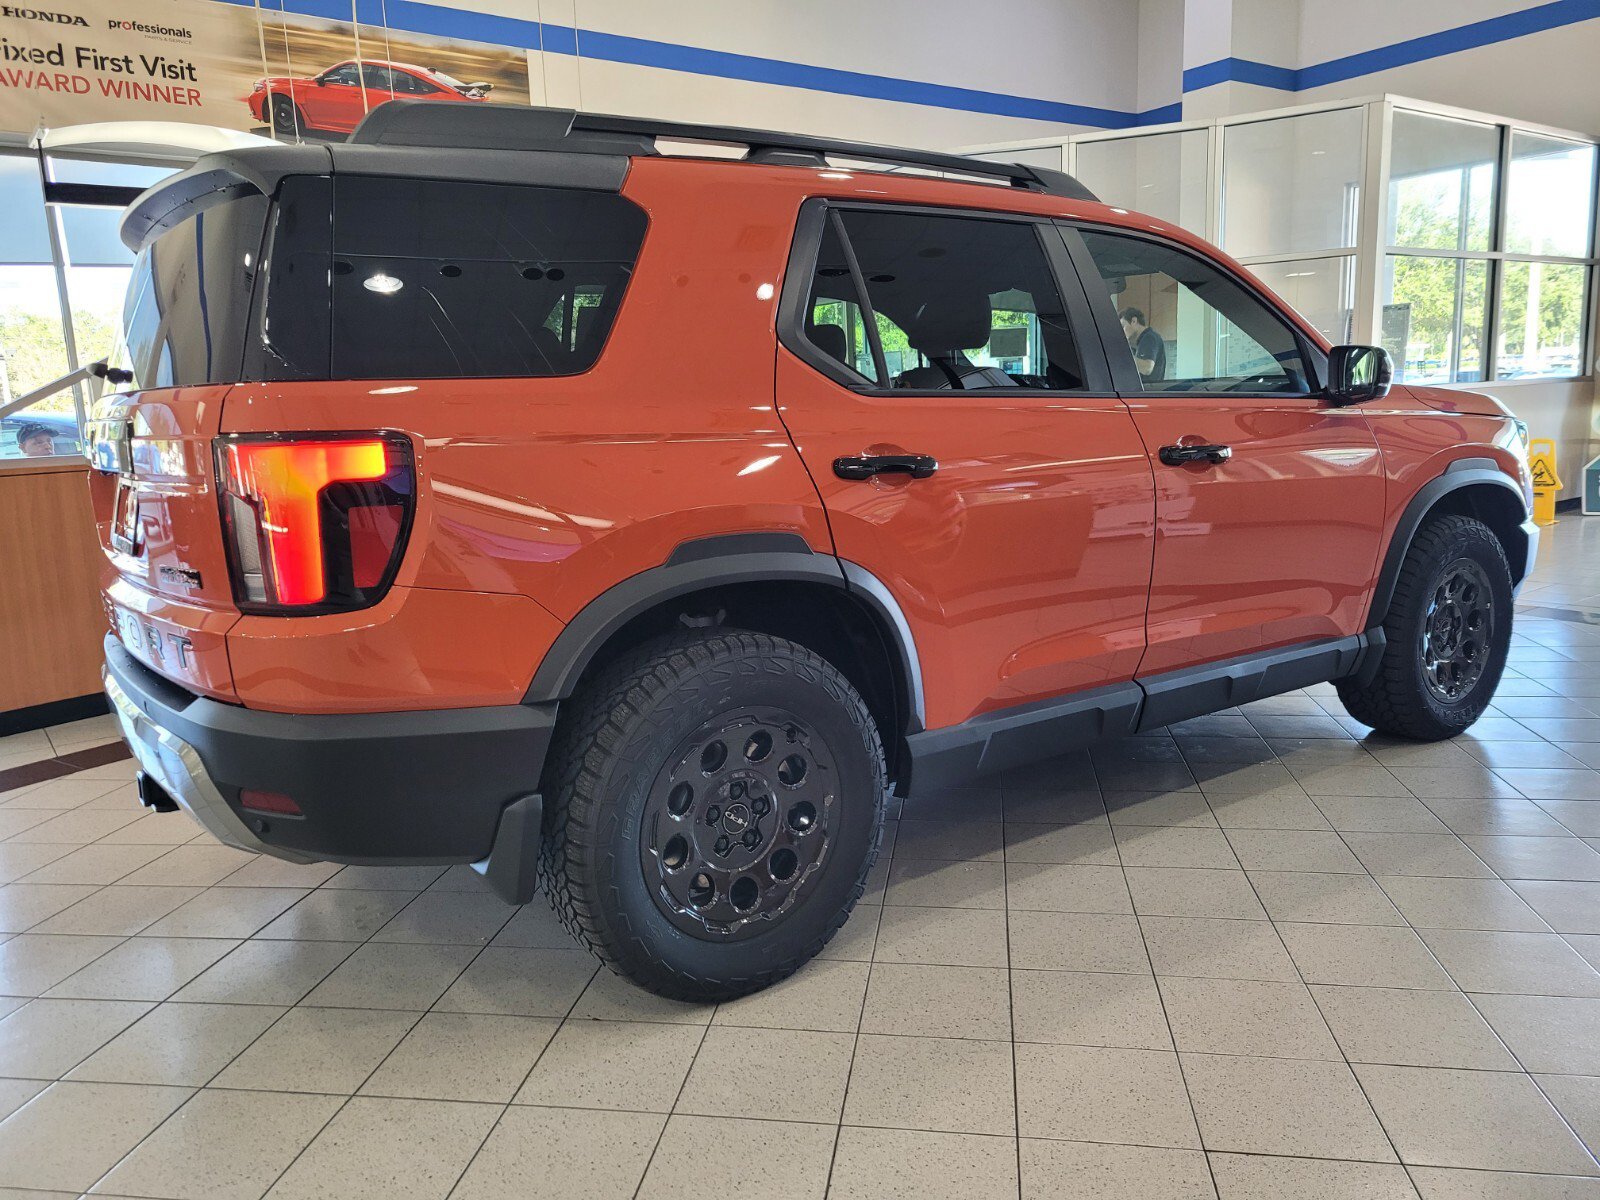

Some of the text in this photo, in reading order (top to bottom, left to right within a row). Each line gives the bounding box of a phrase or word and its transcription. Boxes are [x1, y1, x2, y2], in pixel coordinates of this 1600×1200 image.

[1, 5, 91, 28] HONDA
[108, 19, 193, 39] professionals
[0, 37, 198, 82] ixed First Visit
[98, 78, 202, 107] WINNER
